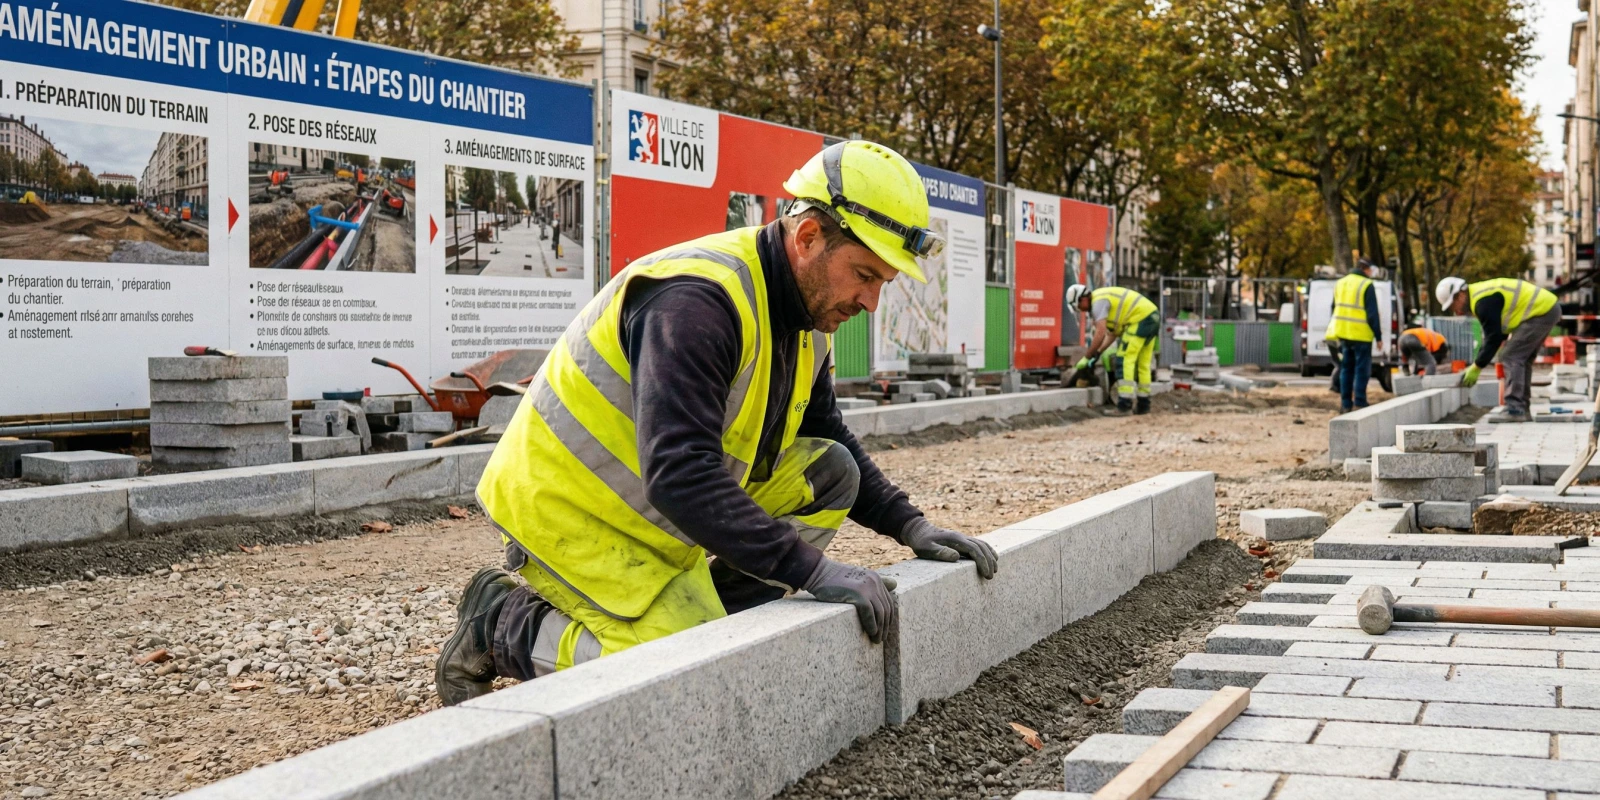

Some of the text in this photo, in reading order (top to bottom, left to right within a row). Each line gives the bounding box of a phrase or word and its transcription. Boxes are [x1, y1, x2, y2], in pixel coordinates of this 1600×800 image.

[0, 2, 526, 119] AMÉNAGEMENT URBAIN : ÉTAPES DU CHANTIER
[16, 80, 121, 113] PRÉPARATION
[127, 97, 146, 116] DU
[150, 100, 208, 124] TERRAIN
[248, 112, 377, 145] 2. POSE DES RÉSEAUX
[660, 115, 704, 140] VILLE DE
[444, 138, 586, 171] 3. AMÉNAGEMENTS DE SURFACE
[661, 137, 704, 172] LYON
[1035, 216, 1055, 235] LYON
[8, 274, 64, 290] Préparation
[66, 276, 79, 289] du
[81, 277, 114, 291] terrain,
[257, 281, 276, 293] Pose
[8, 292, 64, 305] du chantier.
[257, 296, 276, 308] Pose
[8, 308, 78, 325] Aménagement
[256, 340, 315, 353] Aménagements
[316, 340, 326, 350] de
